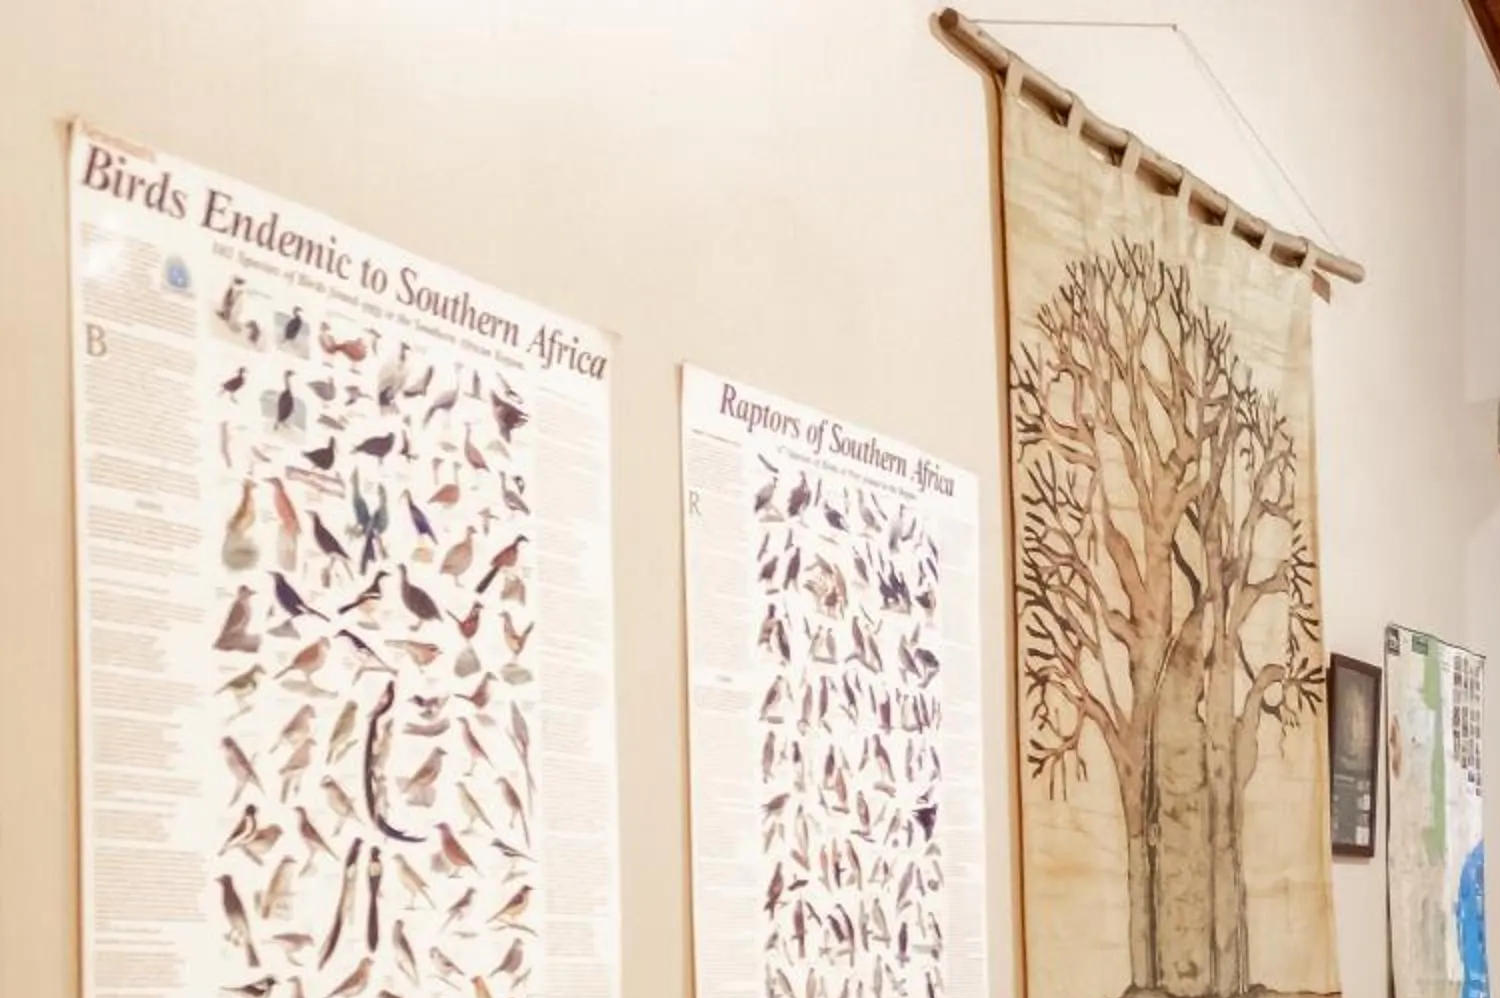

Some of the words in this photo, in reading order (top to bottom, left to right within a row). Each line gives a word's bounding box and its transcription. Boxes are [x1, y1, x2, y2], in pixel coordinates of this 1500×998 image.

[82, 144, 188, 220] Birds
[200, 188, 352, 280] Endemic
[361, 259, 388, 294] to
[396, 266, 520, 347] Southern
[526, 324, 608, 381] Africa
[85, 322, 107, 358] B
[719, 382, 800, 438] Raptors
[805, 418, 828, 455] of
[828, 423, 908, 477] Southern
[910, 456, 955, 497] Africa
